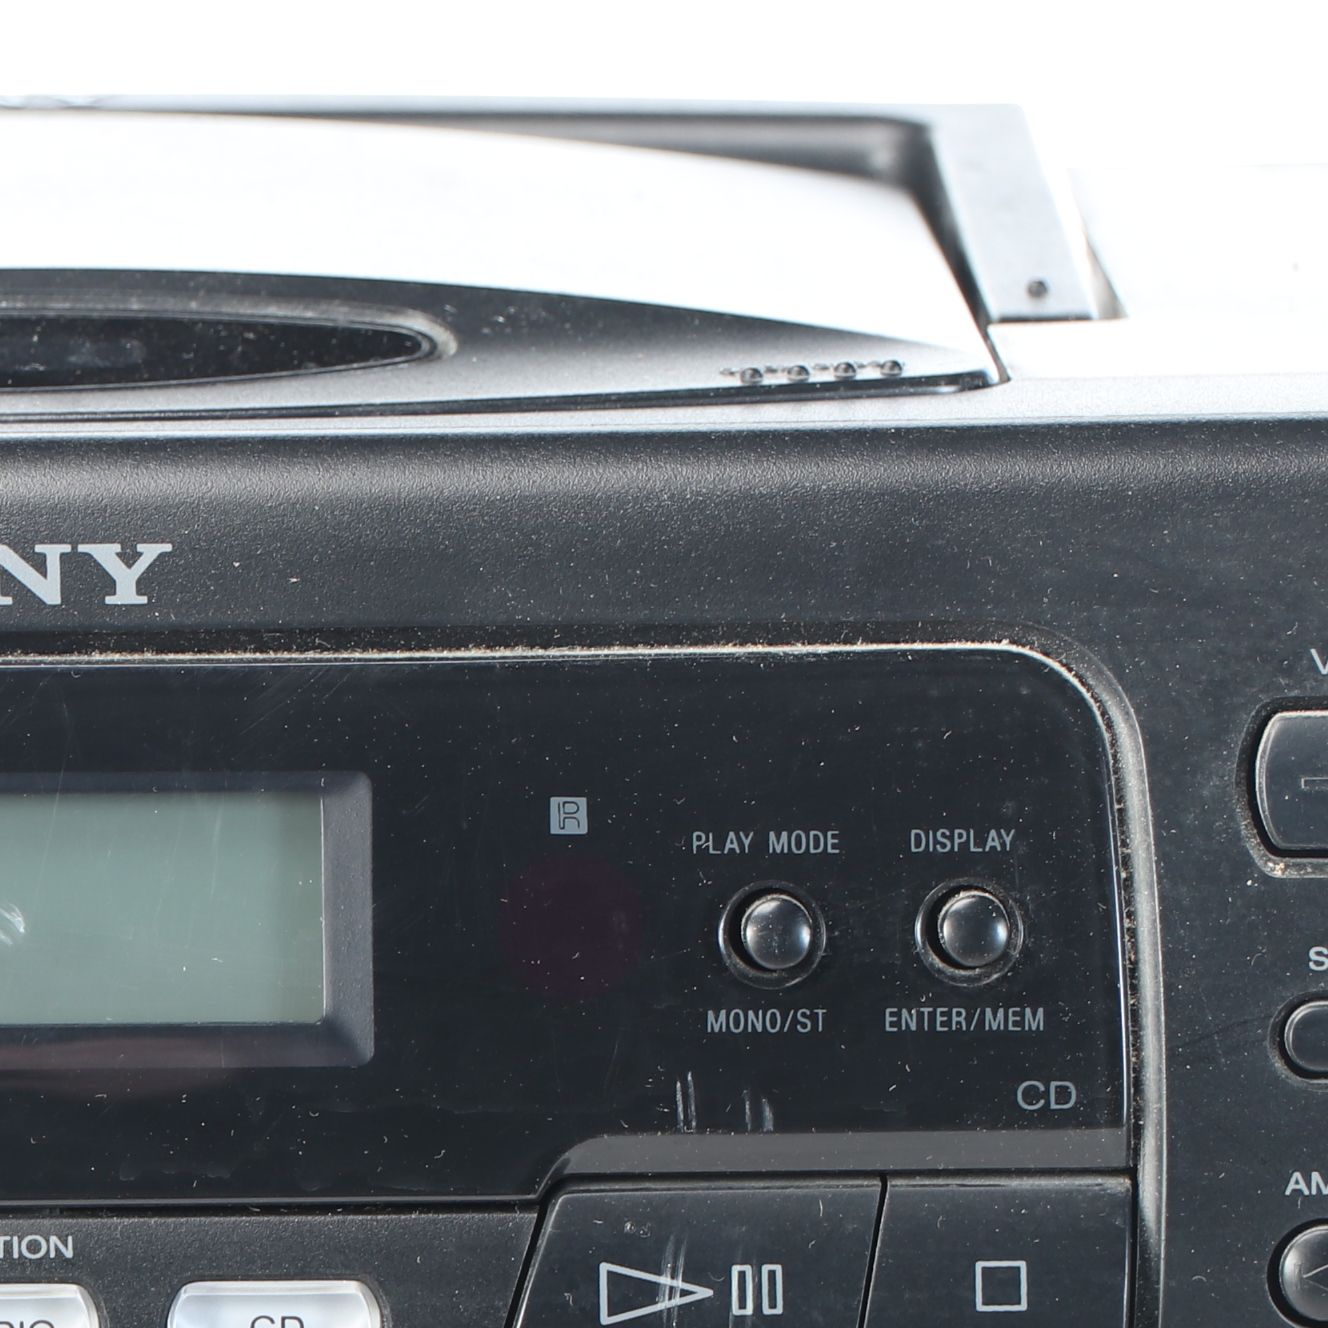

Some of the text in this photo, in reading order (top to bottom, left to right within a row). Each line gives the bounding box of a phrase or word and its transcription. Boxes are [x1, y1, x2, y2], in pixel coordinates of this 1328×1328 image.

[693, 830, 839, 853] PLAY MODE
[911, 829, 1014, 852] DISPLAY
[708, 1009, 826, 1033] MONO/ST
[886, 1008, 1043, 1031] ENTER/MEM
[1017, 1081, 1076, 1110] CD
